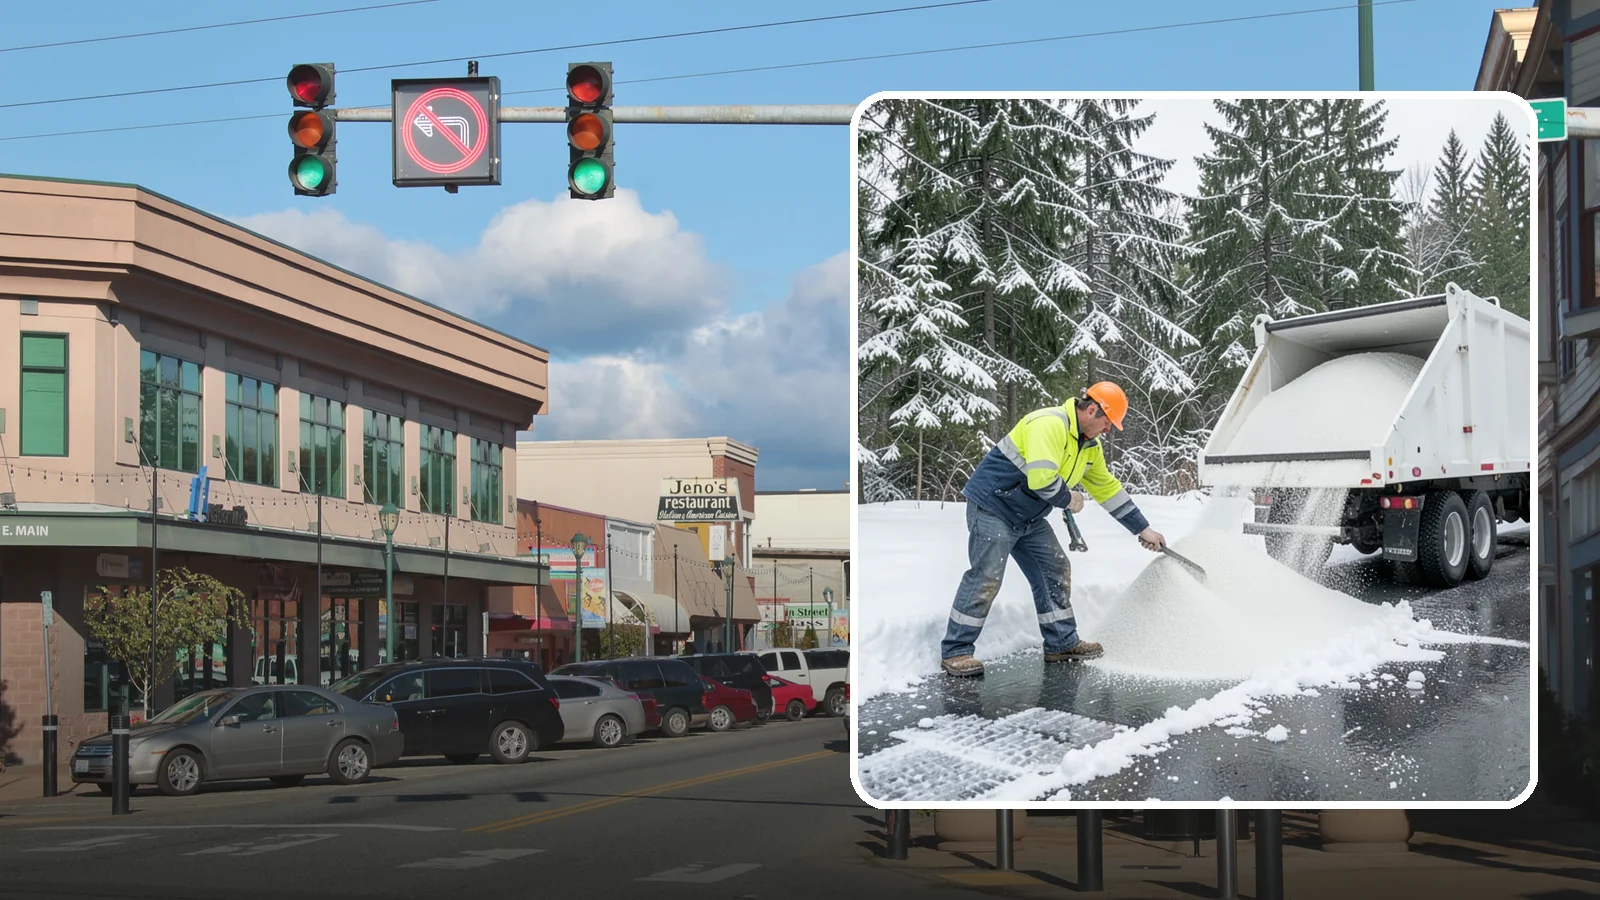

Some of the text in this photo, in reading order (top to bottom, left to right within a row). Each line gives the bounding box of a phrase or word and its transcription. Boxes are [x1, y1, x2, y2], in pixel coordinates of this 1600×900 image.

[669, 480, 728, 494] Jeno's
[665, 496, 731, 509] restaurant
[658, 509, 681, 519] Italian
[686, 509, 714, 519] American
[714, 509, 737, 519] Cuisine
[2, 525, 49, 536] E. MAIN
[797, 607, 828, 617] Street
